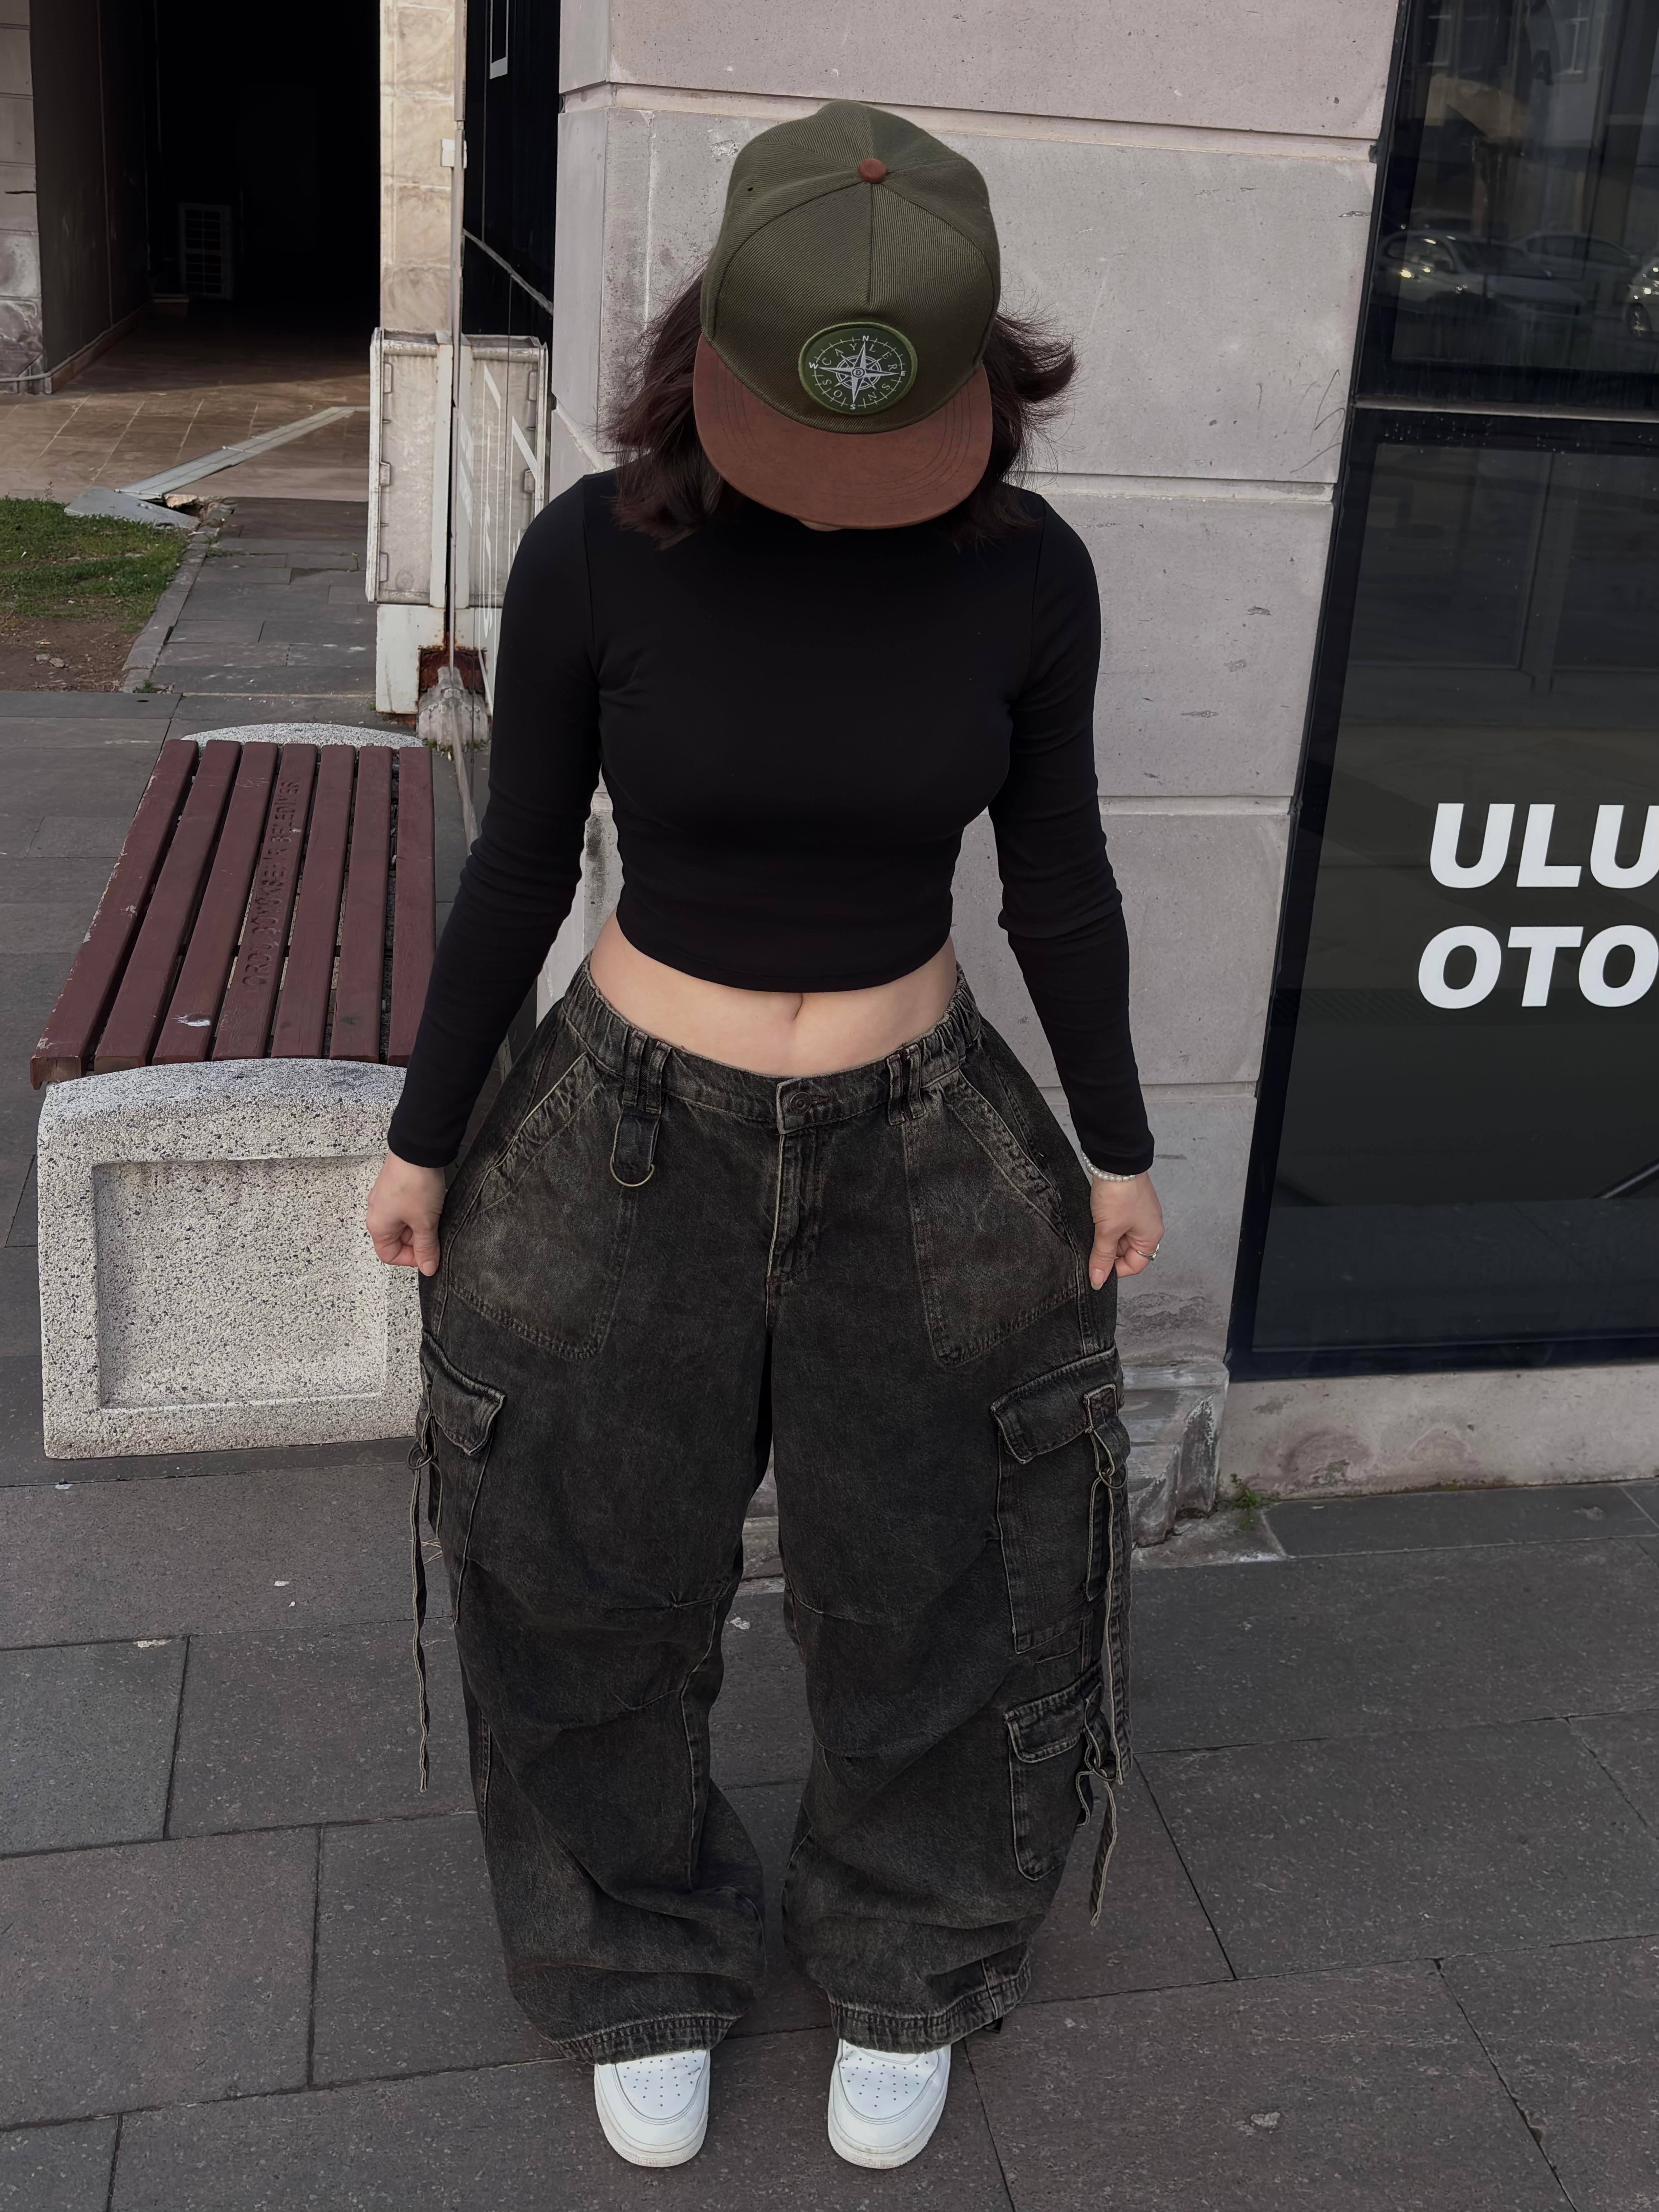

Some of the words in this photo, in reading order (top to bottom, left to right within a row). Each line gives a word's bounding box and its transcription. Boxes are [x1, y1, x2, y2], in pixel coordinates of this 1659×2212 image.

[822, 343, 897, 371] CAYLER
[822, 379, 891, 401] SONS
[1430, 803, 1659, 889] ULU
[242, 943, 272, 986] ORDU
[1418, 925, 1659, 1009] OTO
